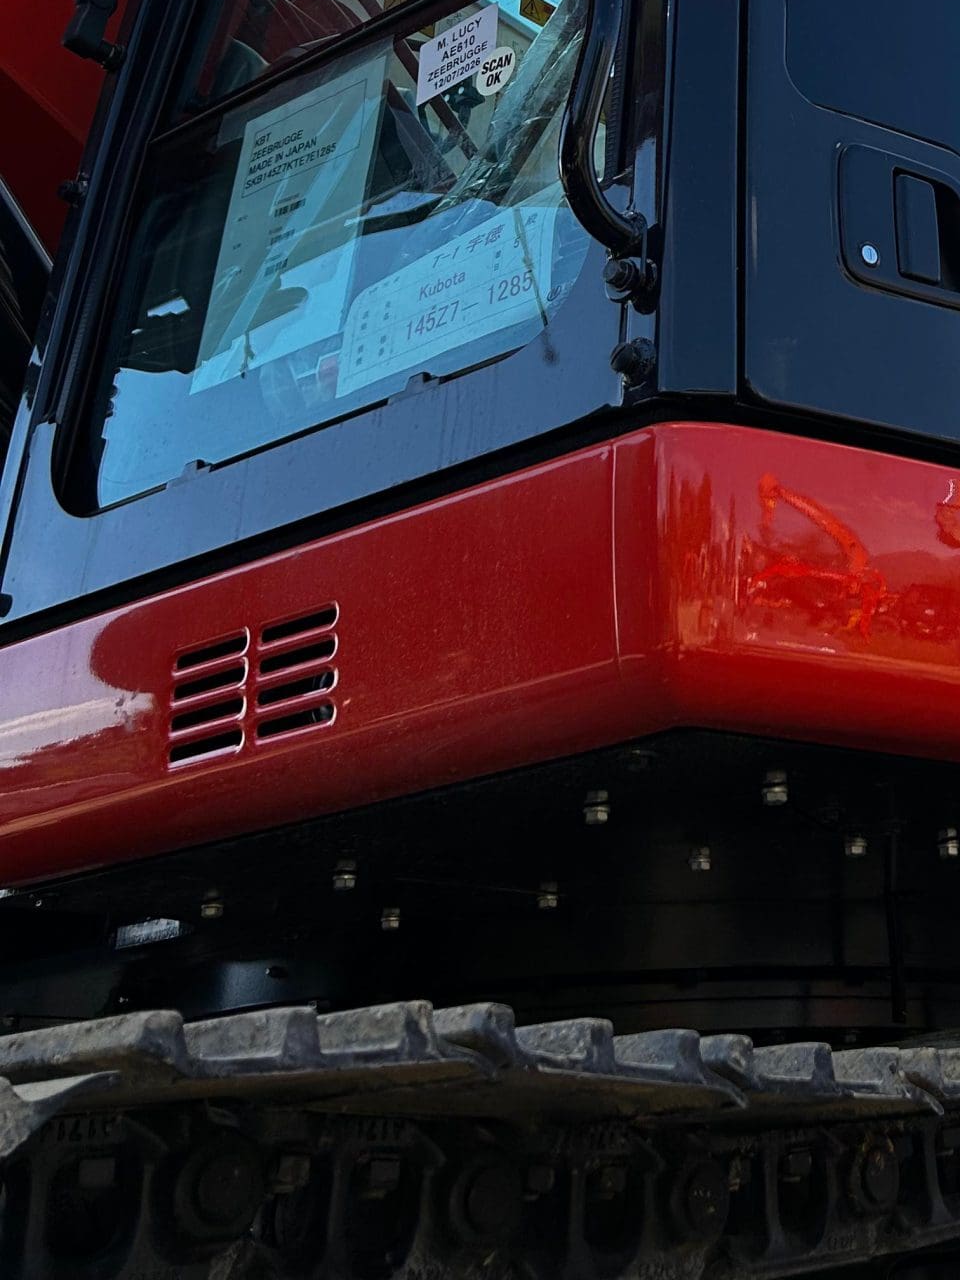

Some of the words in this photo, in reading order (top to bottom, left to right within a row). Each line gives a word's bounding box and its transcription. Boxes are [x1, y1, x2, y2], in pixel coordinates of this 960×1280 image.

[437, 37, 449, 51] M.
[452, 17, 482, 42] LUCY
[441, 35, 475, 61] AE610
[427, 41, 488, 82] ZEEBRUGGE
[481, 53, 513, 75] SCAN
[486, 71, 502, 87] OK
[249, 130, 303, 162] ZEEBRUGGE
[255, 132, 272, 147] KBT
[248, 156, 273, 174] MADE
[275, 151, 284, 162] IN
[286, 136, 317, 157] JAPAN
[419, 271, 466, 300] Kubota
[488, 270, 533, 304] 1285
